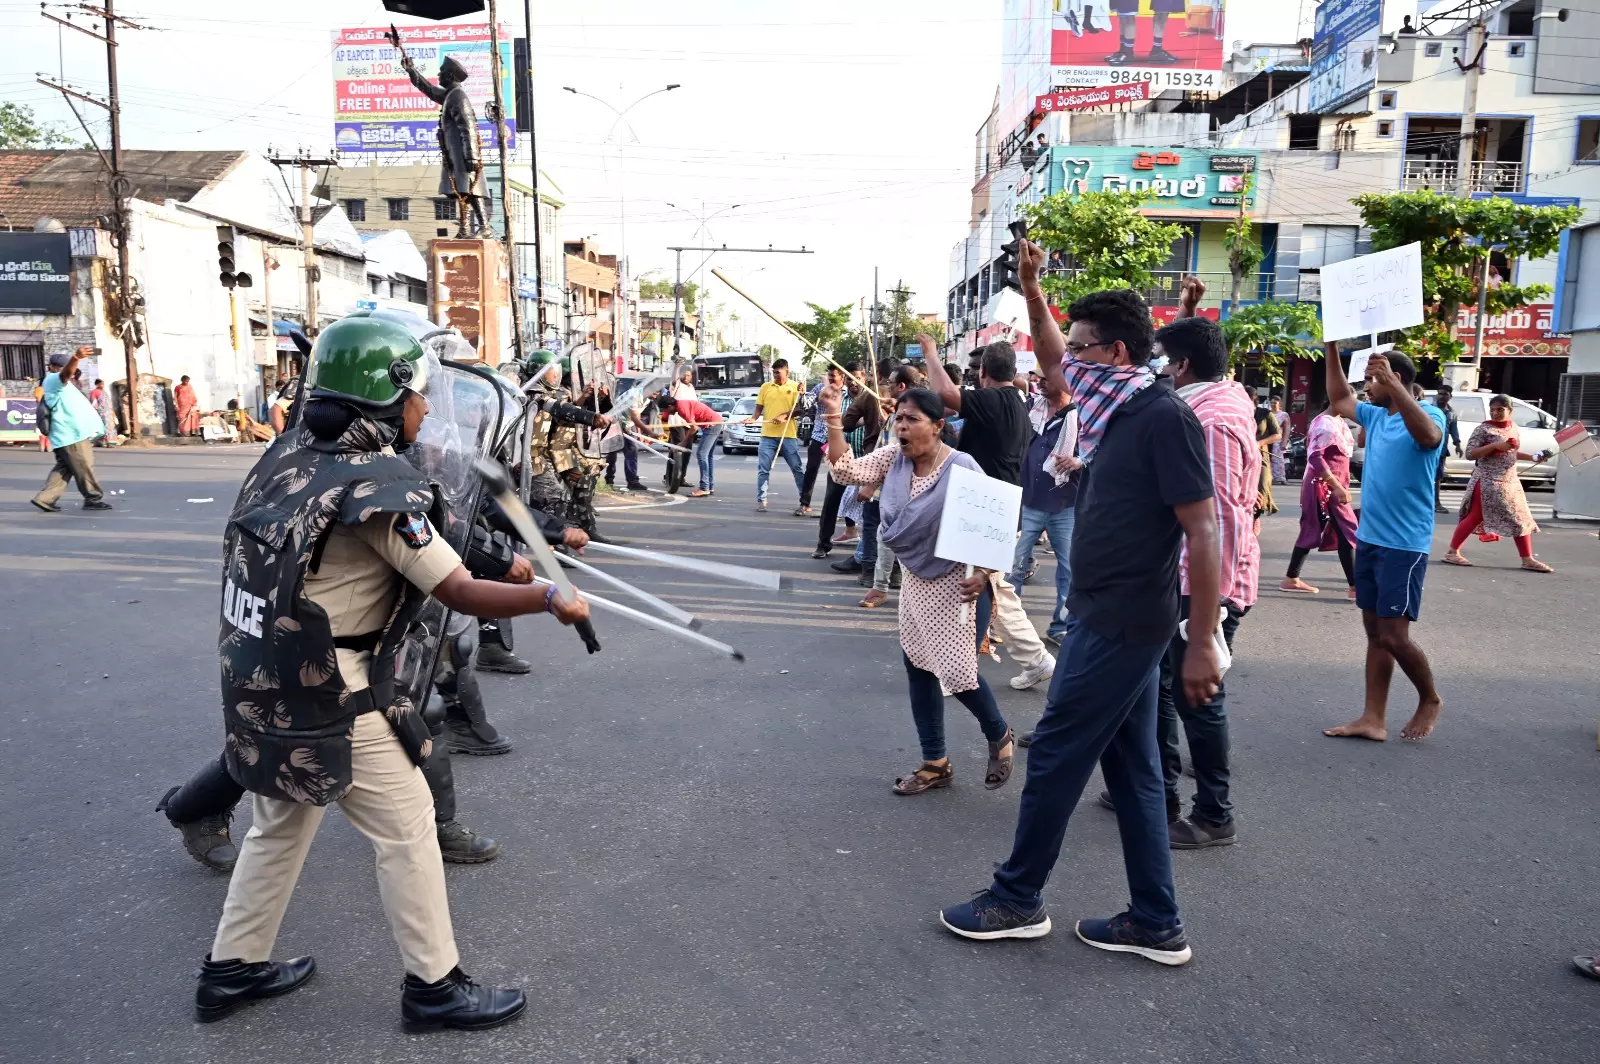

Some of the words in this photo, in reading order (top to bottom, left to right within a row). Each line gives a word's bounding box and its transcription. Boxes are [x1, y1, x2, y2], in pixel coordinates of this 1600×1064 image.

[336, 50, 345, 62] AP
[404, 47, 437, 59] EE-MAIN
[370, 63, 392, 75] 120
[1110, 70, 1160, 85] 98491
[1165, 72, 1214, 87] 15934
[348, 82, 386, 95] Online
[340, 98, 372, 111] FREE
[373, 96, 436, 110] TRAINING
[69, 229, 97, 256] BAR
[1336, 264, 1369, 289] WE
[1371, 251, 1413, 283] WANT
[1344, 287, 1413, 318] JUSTICE
[956, 486, 1006, 517] POLICE
